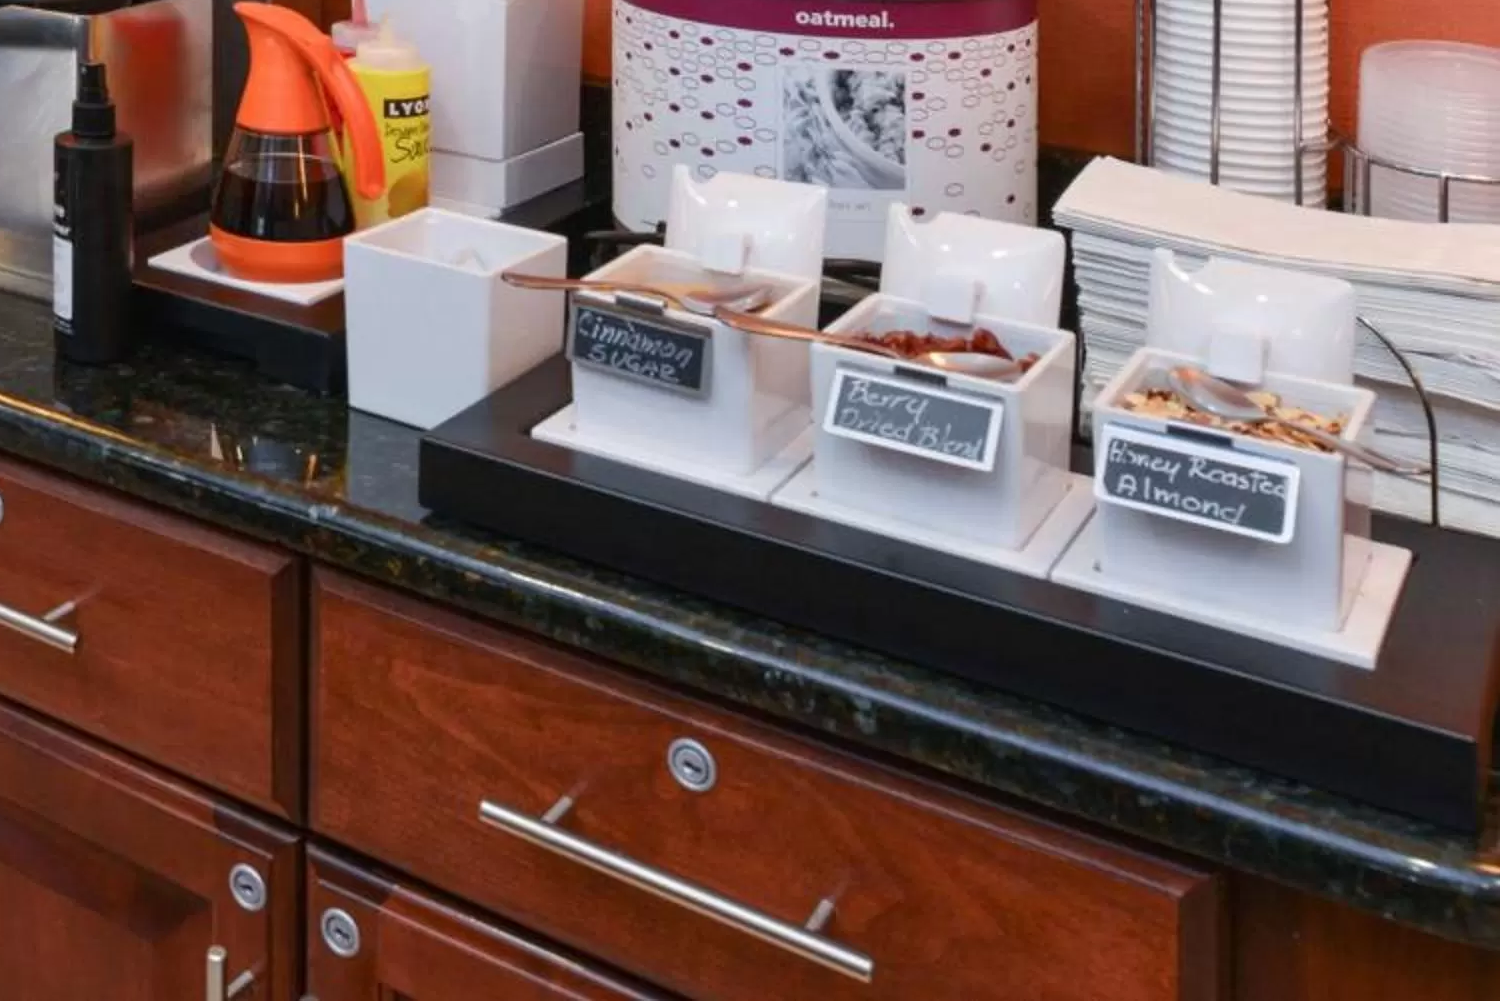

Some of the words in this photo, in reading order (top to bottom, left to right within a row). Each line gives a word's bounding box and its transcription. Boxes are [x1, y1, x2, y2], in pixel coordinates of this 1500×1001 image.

[795, 10, 896, 29] oatmeal.
[587, 344, 681, 384] SUGAR
[847, 380, 930, 425] Berry
[840, 407, 915, 442] Dried
[917, 421, 984, 461] Blend
[1115, 474, 1248, 524] Almond
